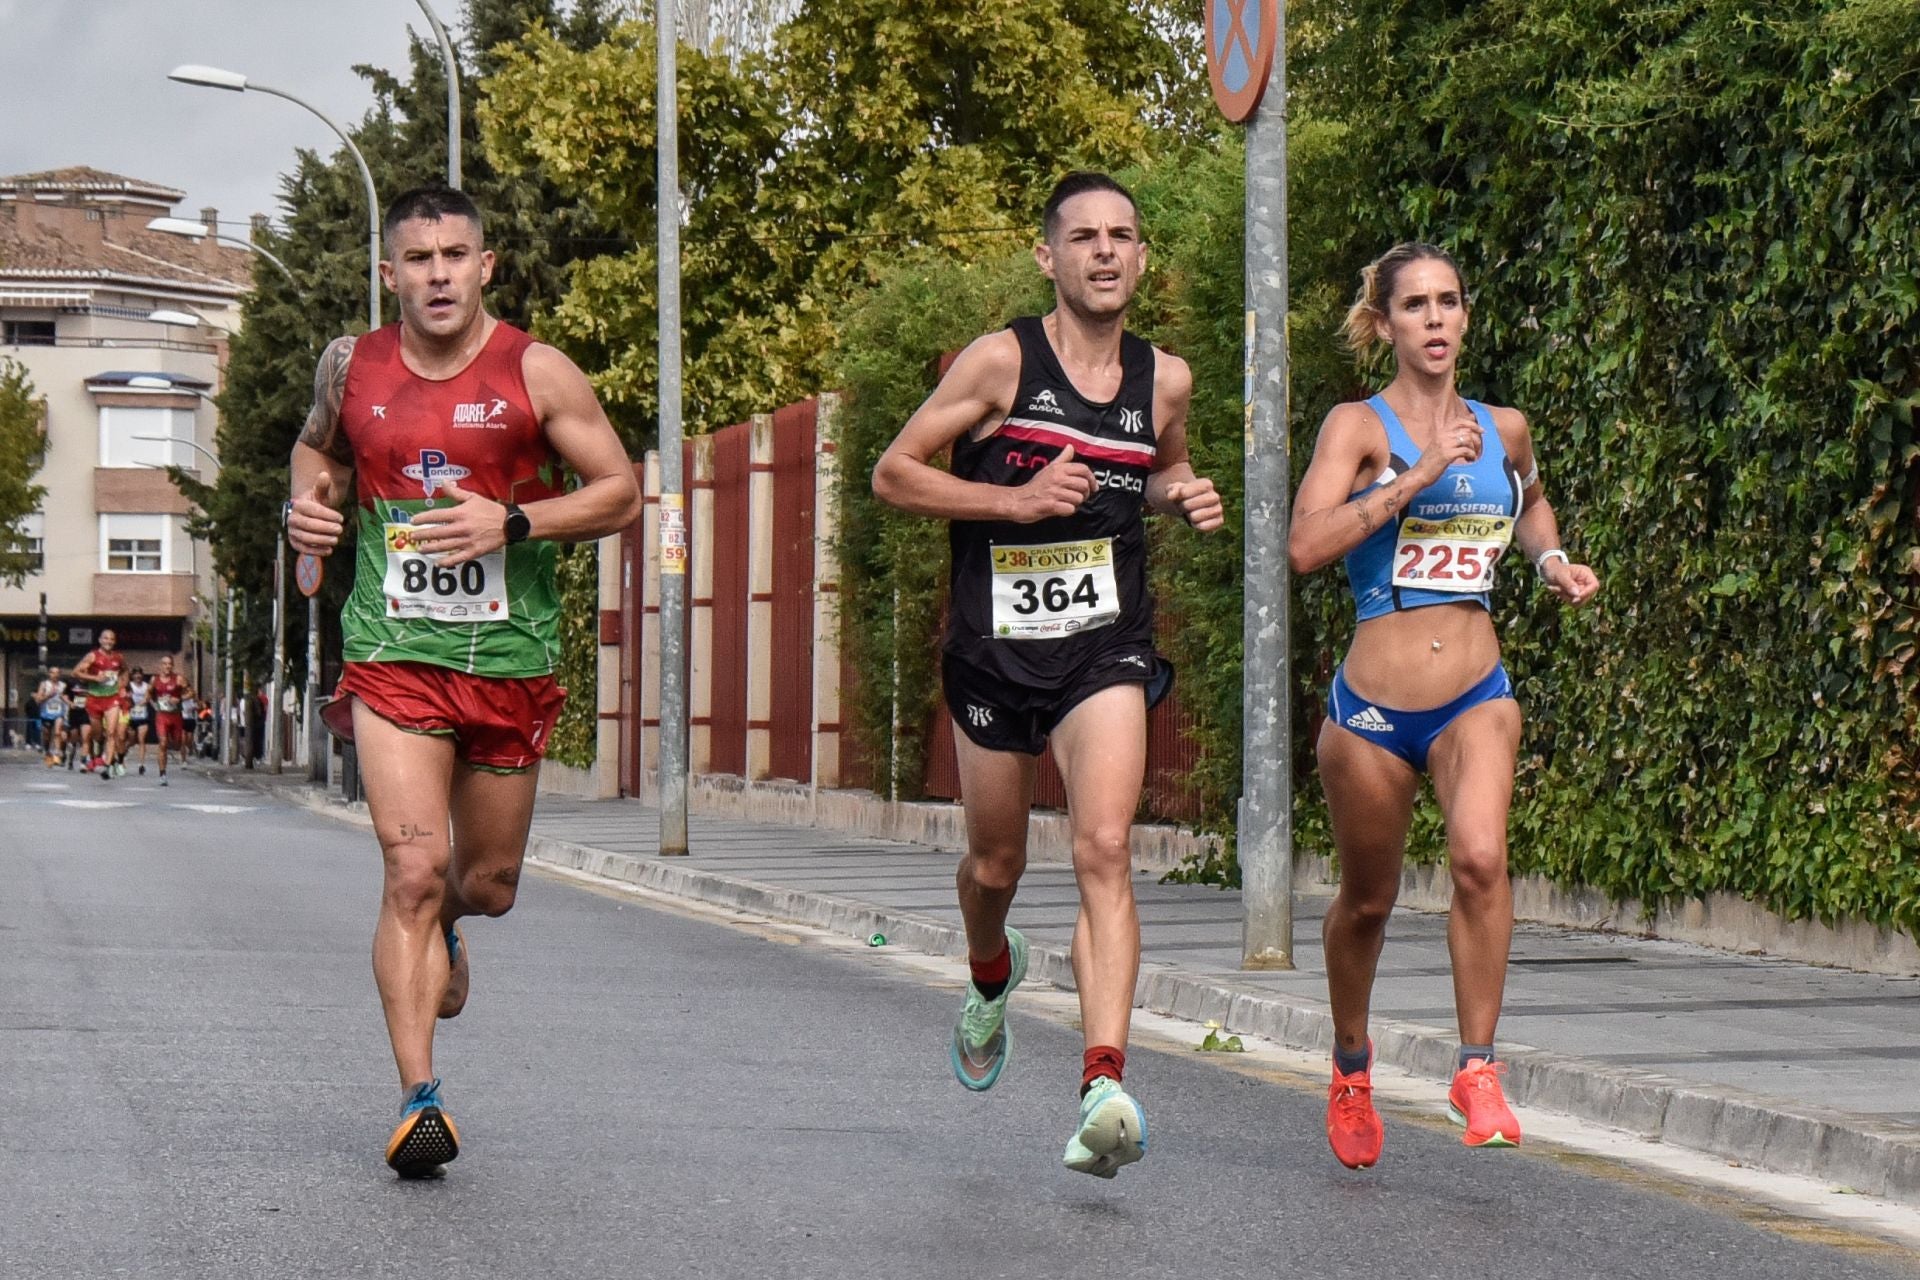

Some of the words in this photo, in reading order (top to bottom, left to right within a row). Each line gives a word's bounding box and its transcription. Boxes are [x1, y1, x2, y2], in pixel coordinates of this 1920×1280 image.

[453, 403, 486, 422] ATARFE
[1028, 402, 1065, 416] austral
[1418, 503, 1504, 515] TROTASIERRA
[1053, 545, 1083, 554] PREMIO
[1008, 551, 1028, 567] 38
[1028, 551, 1089, 567] FONDO
[402, 558, 485, 596] 860
[1012, 573, 1100, 615] 364
[1347, 718, 1394, 732] adidas
